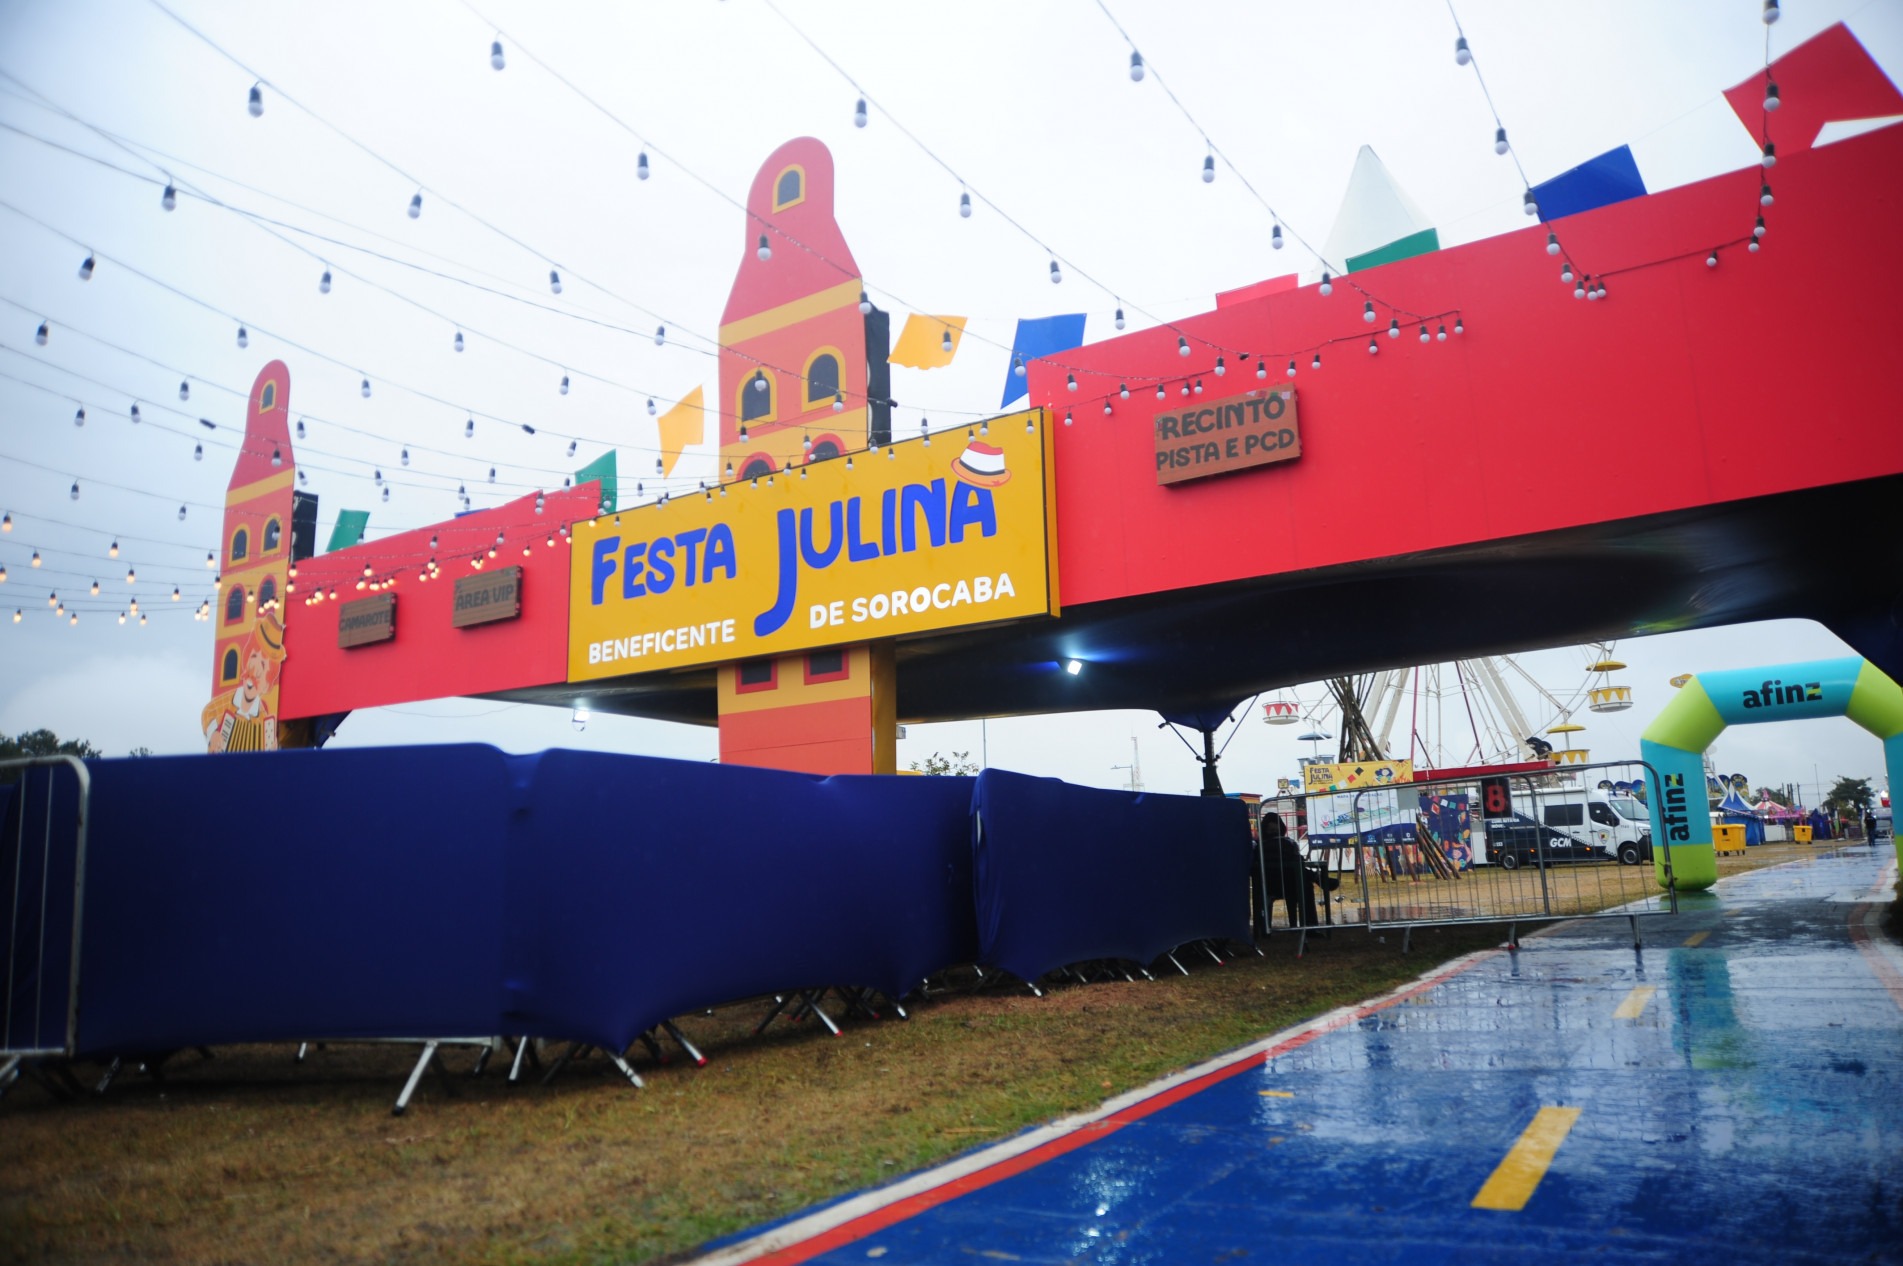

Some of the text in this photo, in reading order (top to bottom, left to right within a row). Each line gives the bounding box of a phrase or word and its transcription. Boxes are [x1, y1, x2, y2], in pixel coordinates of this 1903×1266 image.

[1162, 395, 1286, 440] RECINTO
[1156, 429, 1295, 471] PISTA E PCD
[591, 477, 997, 637] FESTA JULINA
[492, 584, 515, 603] VIP
[588, 573, 1016, 664] BENEFICENTE DE SOROCABA
[1742, 679, 1823, 709] afinz
[1309, 772, 1333, 785] JULINA
[1486, 784, 1507, 813] 8
[1664, 773, 1690, 841] afinz
[1549, 838, 1572, 848] GCM
